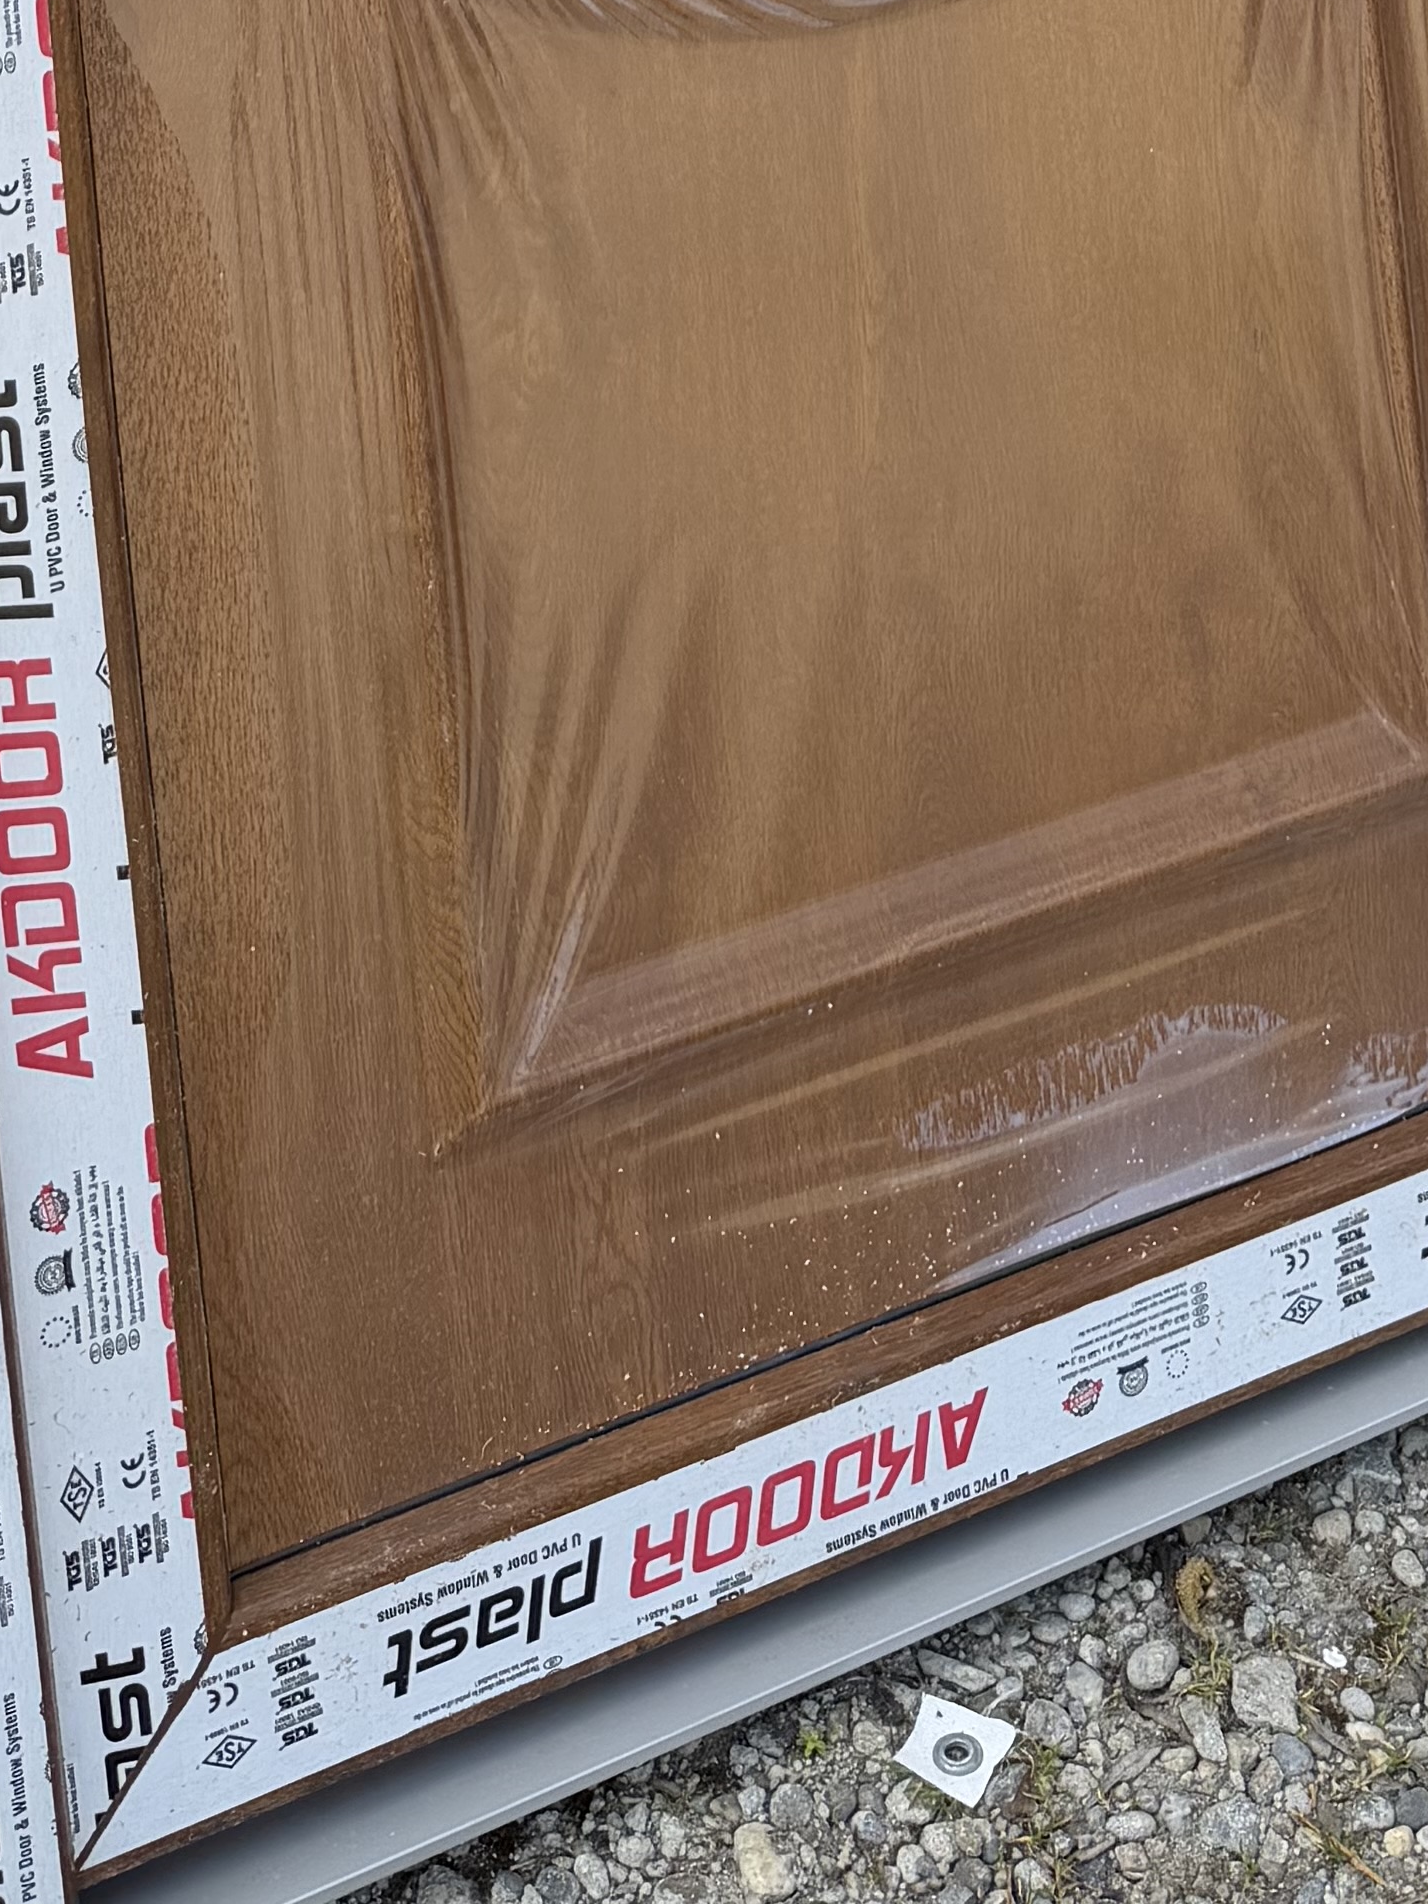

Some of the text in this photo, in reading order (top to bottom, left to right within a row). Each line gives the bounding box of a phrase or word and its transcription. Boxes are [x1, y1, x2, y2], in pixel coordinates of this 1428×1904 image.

[33, 363, 64, 593] U PVC Door & Window Systems
[376, 1532, 580, 1622] U PVC Door & Window Systems
[382, 1389, 987, 1699] AKDOOR plast
